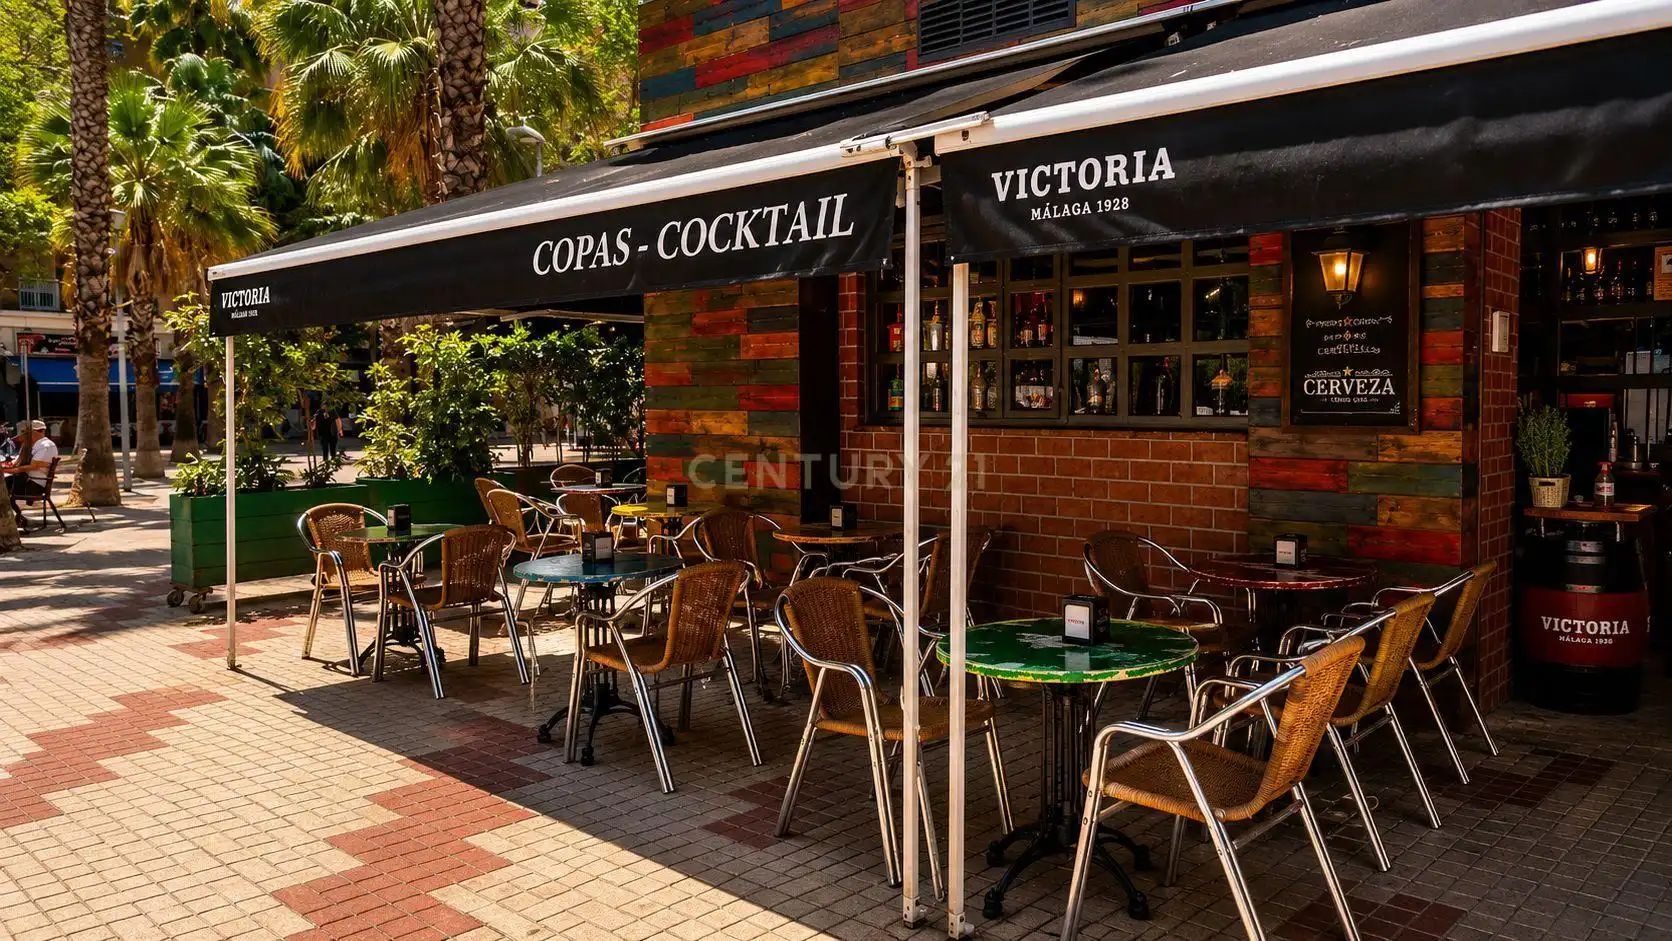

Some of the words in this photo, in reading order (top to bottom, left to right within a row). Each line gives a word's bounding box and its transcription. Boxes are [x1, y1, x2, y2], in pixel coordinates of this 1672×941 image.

[991, 147, 1175, 202] VICTORIA
[1031, 202, 1092, 221] MÁLAGA
[1097, 197, 1130, 213] 1928
[532, 227, 632, 276] COPAS
[638, 243, 648, 252] -
[657, 193, 855, 260] COCKTAIL
[222, 286, 270, 308] VICTORIA
[1303, 378, 1396, 396] CERVEZA
[1541, 616, 1630, 634] VICTORIA
